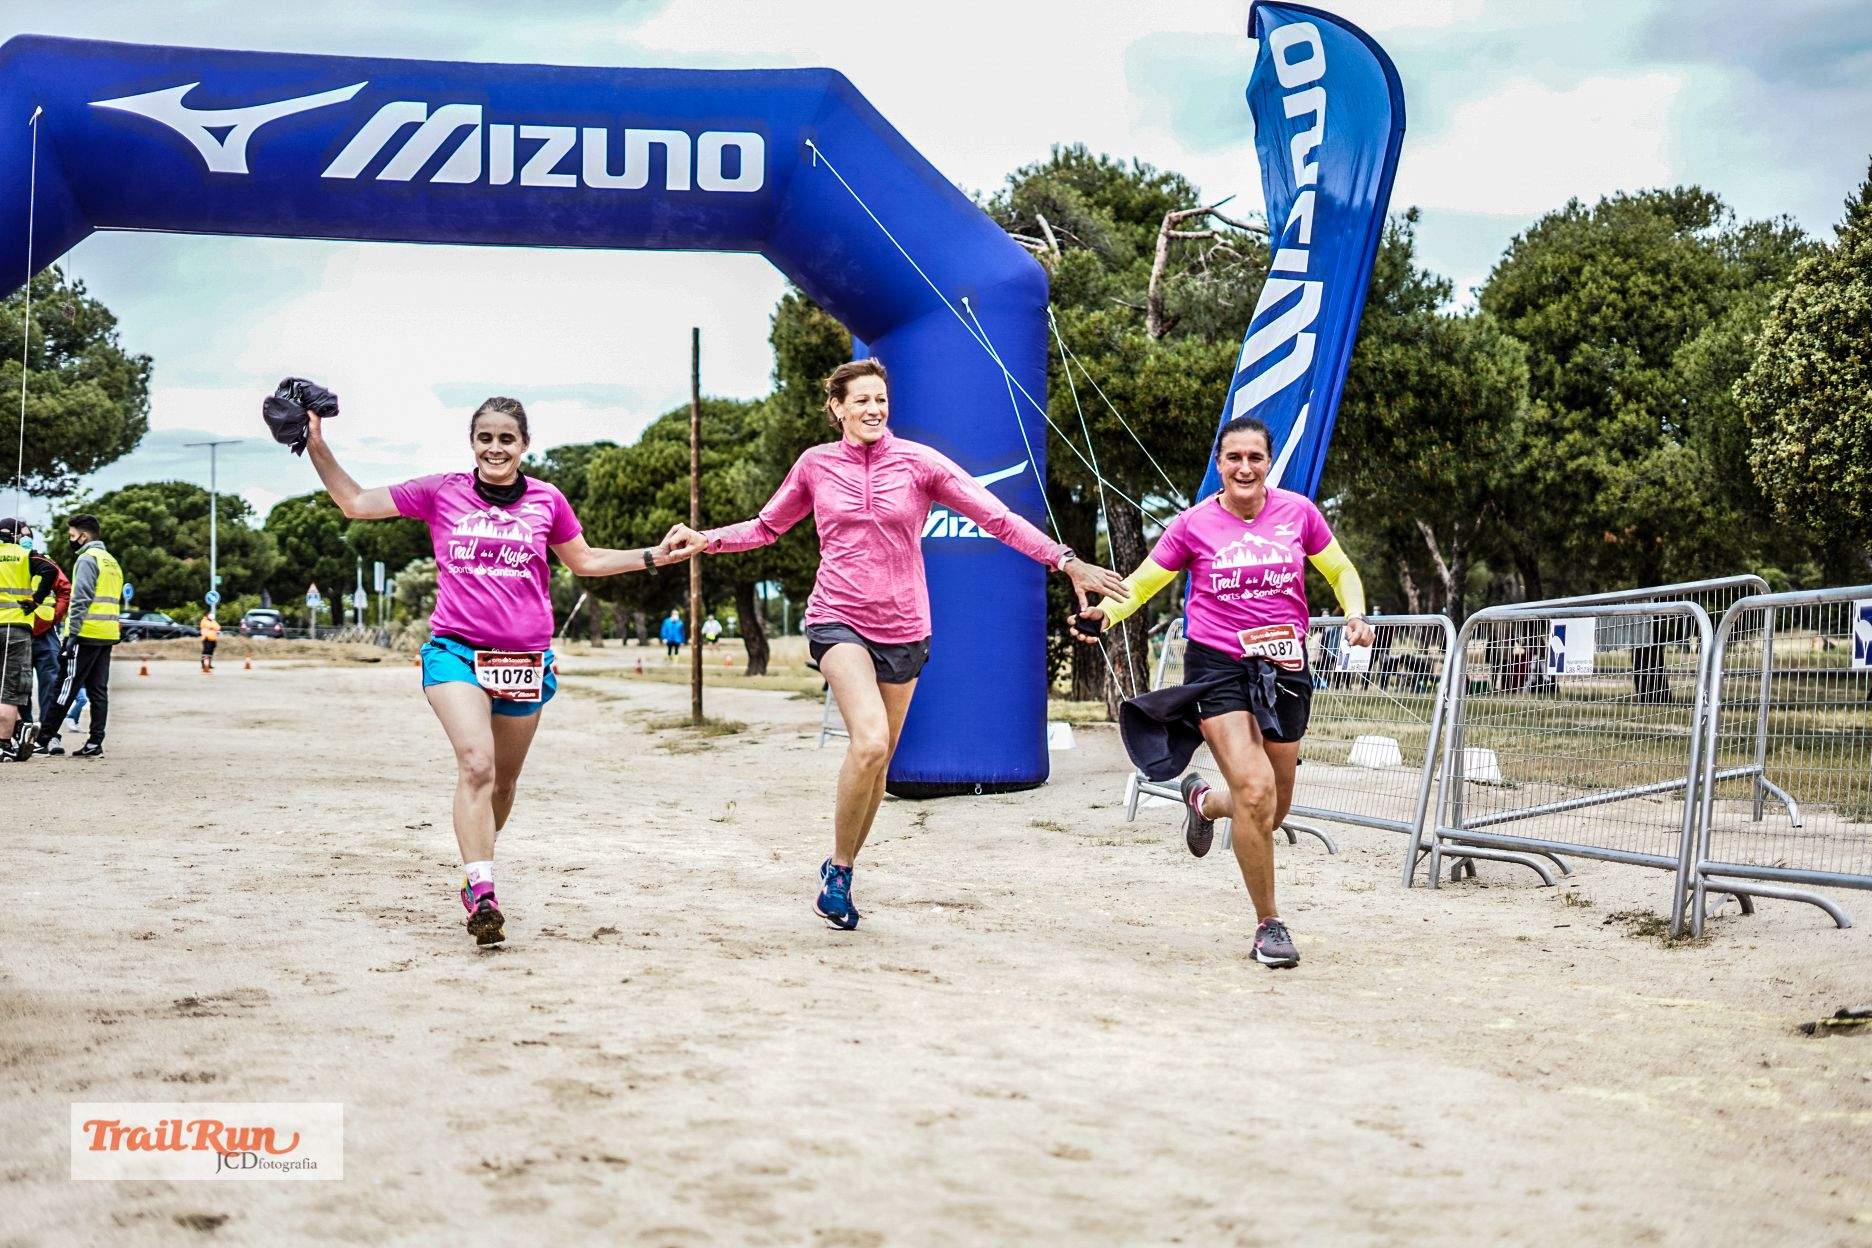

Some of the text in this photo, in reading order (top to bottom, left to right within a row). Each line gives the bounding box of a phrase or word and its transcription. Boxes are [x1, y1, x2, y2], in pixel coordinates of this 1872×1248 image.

[321, 101, 765, 193] MIZUNO
[920, 510, 997, 538] MIZ
[448, 537, 479, 561] Trail
[495, 544, 537, 568] Mujer
[1208, 568, 1242, 593] Trail
[1260, 567, 1298, 589] Mujer
[1216, 592, 1241, 602] ports
[1259, 641, 1293, 656] 1087
[491, 669, 533, 684] 1078
